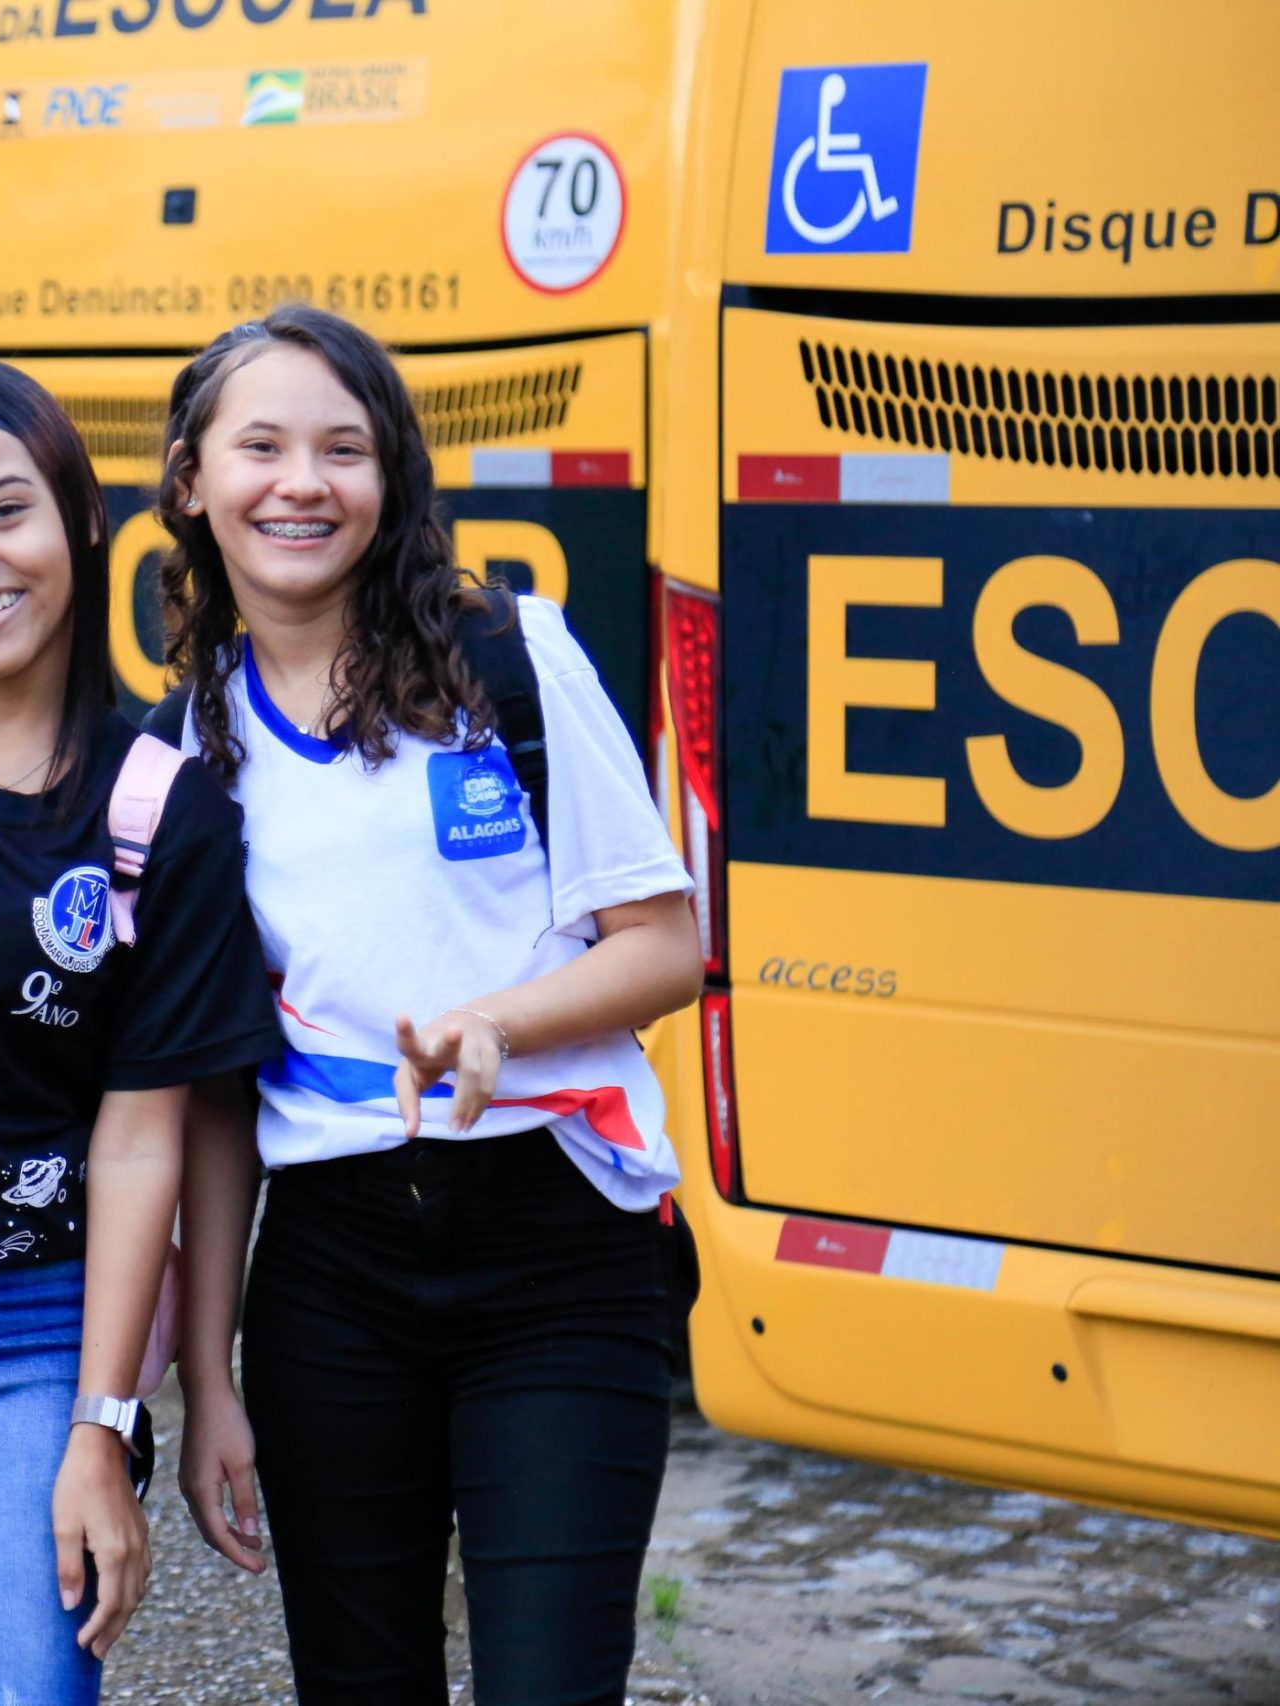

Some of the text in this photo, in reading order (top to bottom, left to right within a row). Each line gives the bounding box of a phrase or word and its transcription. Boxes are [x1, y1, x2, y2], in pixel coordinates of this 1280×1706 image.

[535, 158, 598, 218] 70
[996, 200, 1218, 264] Disque
[326, 271, 460, 313] 616161
[448, 818, 521, 841] ALAGOAS
[34, 898, 50, 942] ESCOLA
[43, 941, 69, 968] MARIA
[758, 956, 898, 999] access
[30, 1003, 80, 1028] ANO
